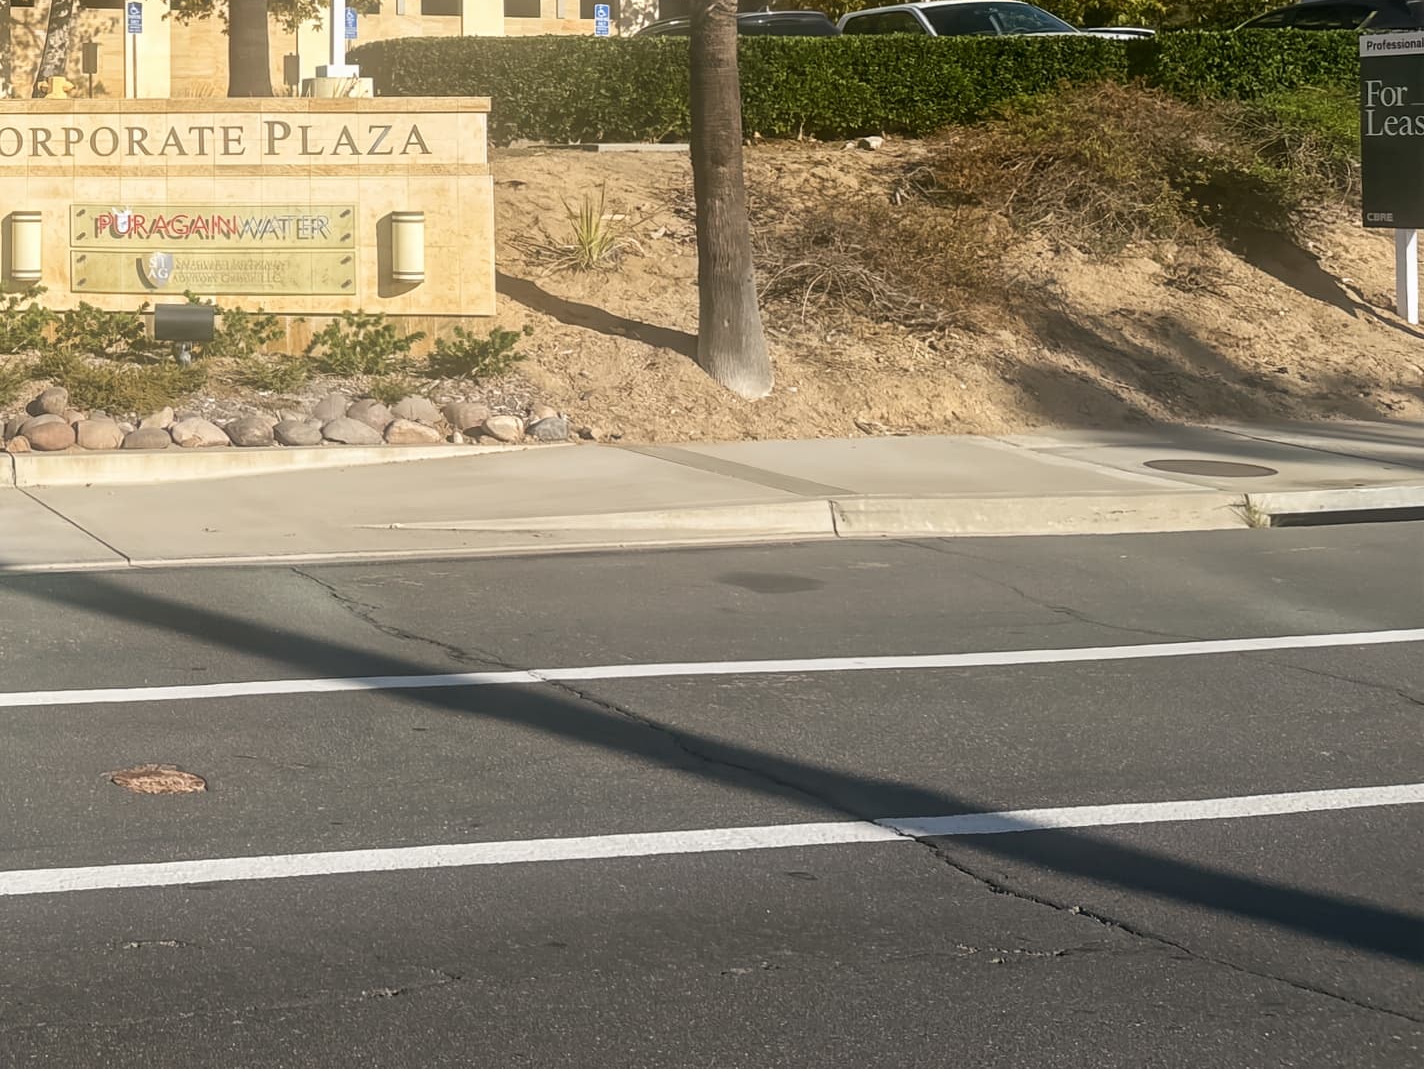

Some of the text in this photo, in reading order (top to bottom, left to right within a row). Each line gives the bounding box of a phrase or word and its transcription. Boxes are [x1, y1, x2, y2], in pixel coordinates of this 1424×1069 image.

[1365, 80, 1408, 107] For
[1365, 109, 1424, 137] Leas
[263, 120, 433, 156] PLAZA
[1366, 212, 1394, 222] CBRE
